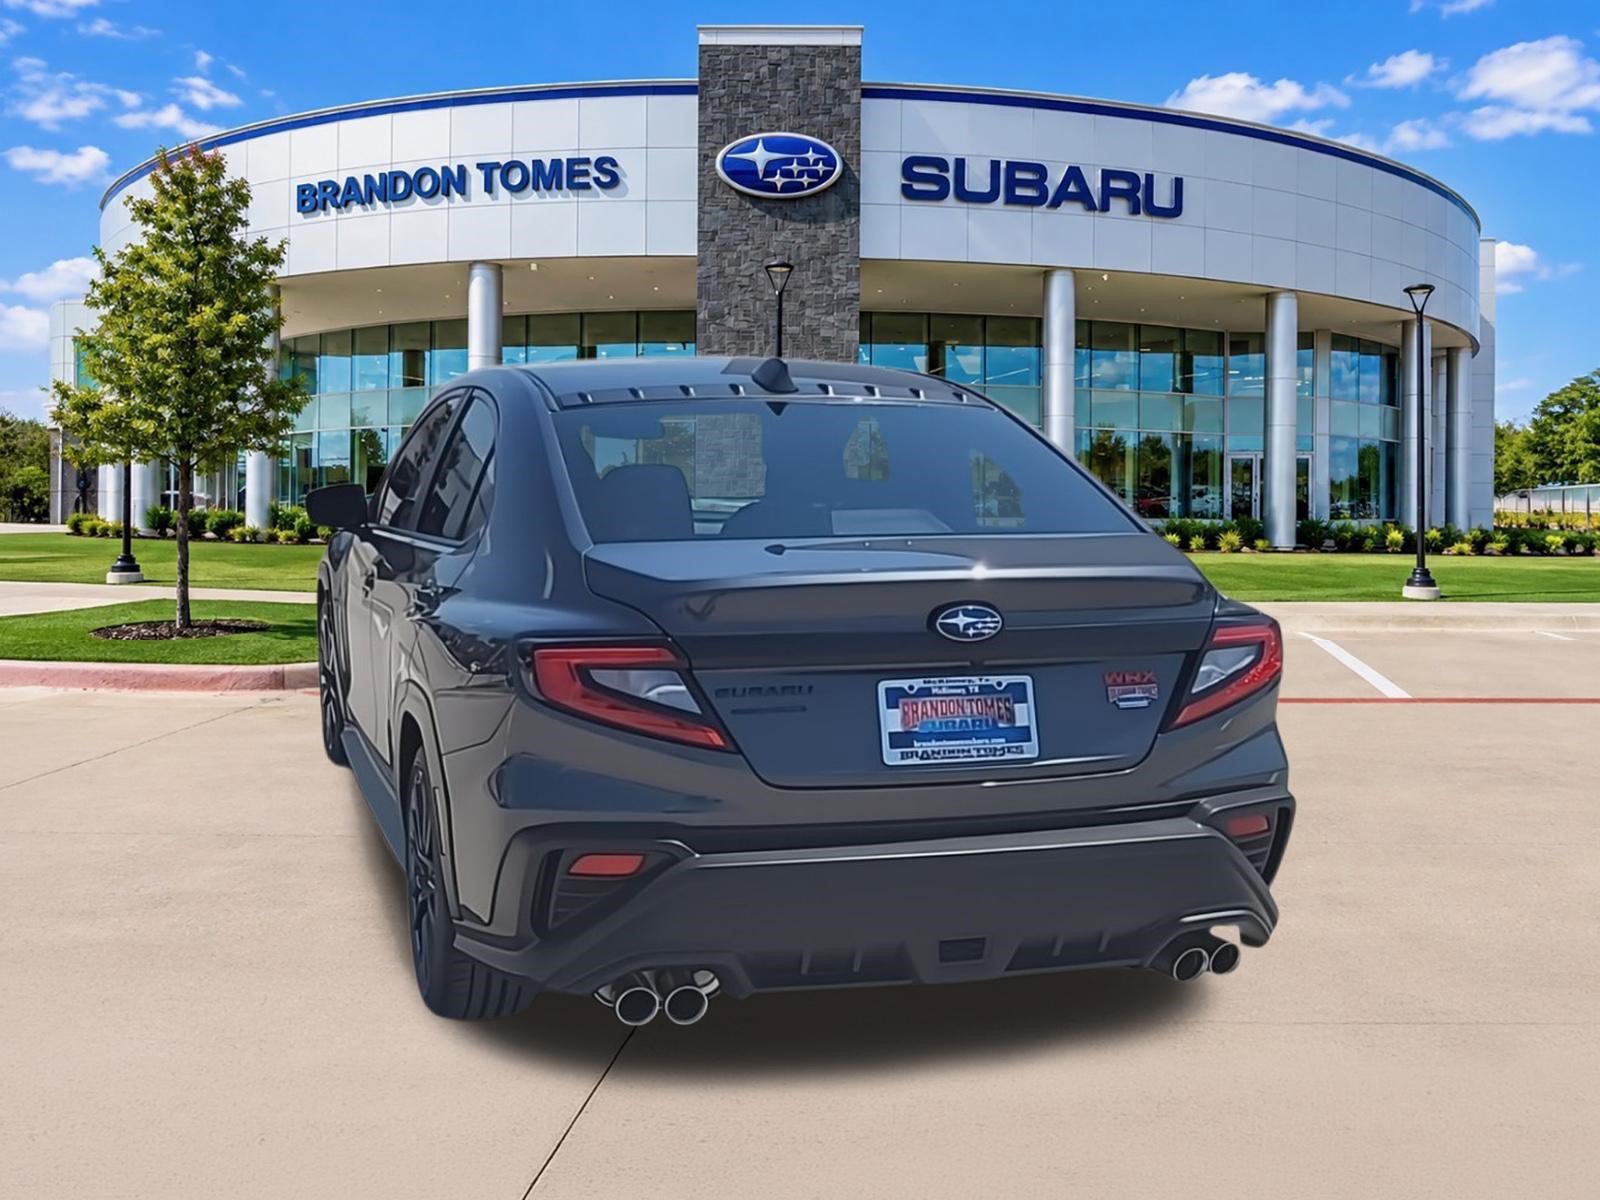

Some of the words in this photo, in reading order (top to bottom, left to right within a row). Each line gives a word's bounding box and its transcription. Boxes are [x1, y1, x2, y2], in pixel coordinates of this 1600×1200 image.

[297, 164, 466, 213] BRANDON
[476, 156, 621, 194] TOMES
[900, 155, 1184, 218] SUBARU
[1104, 671, 1155, 685] WRX
